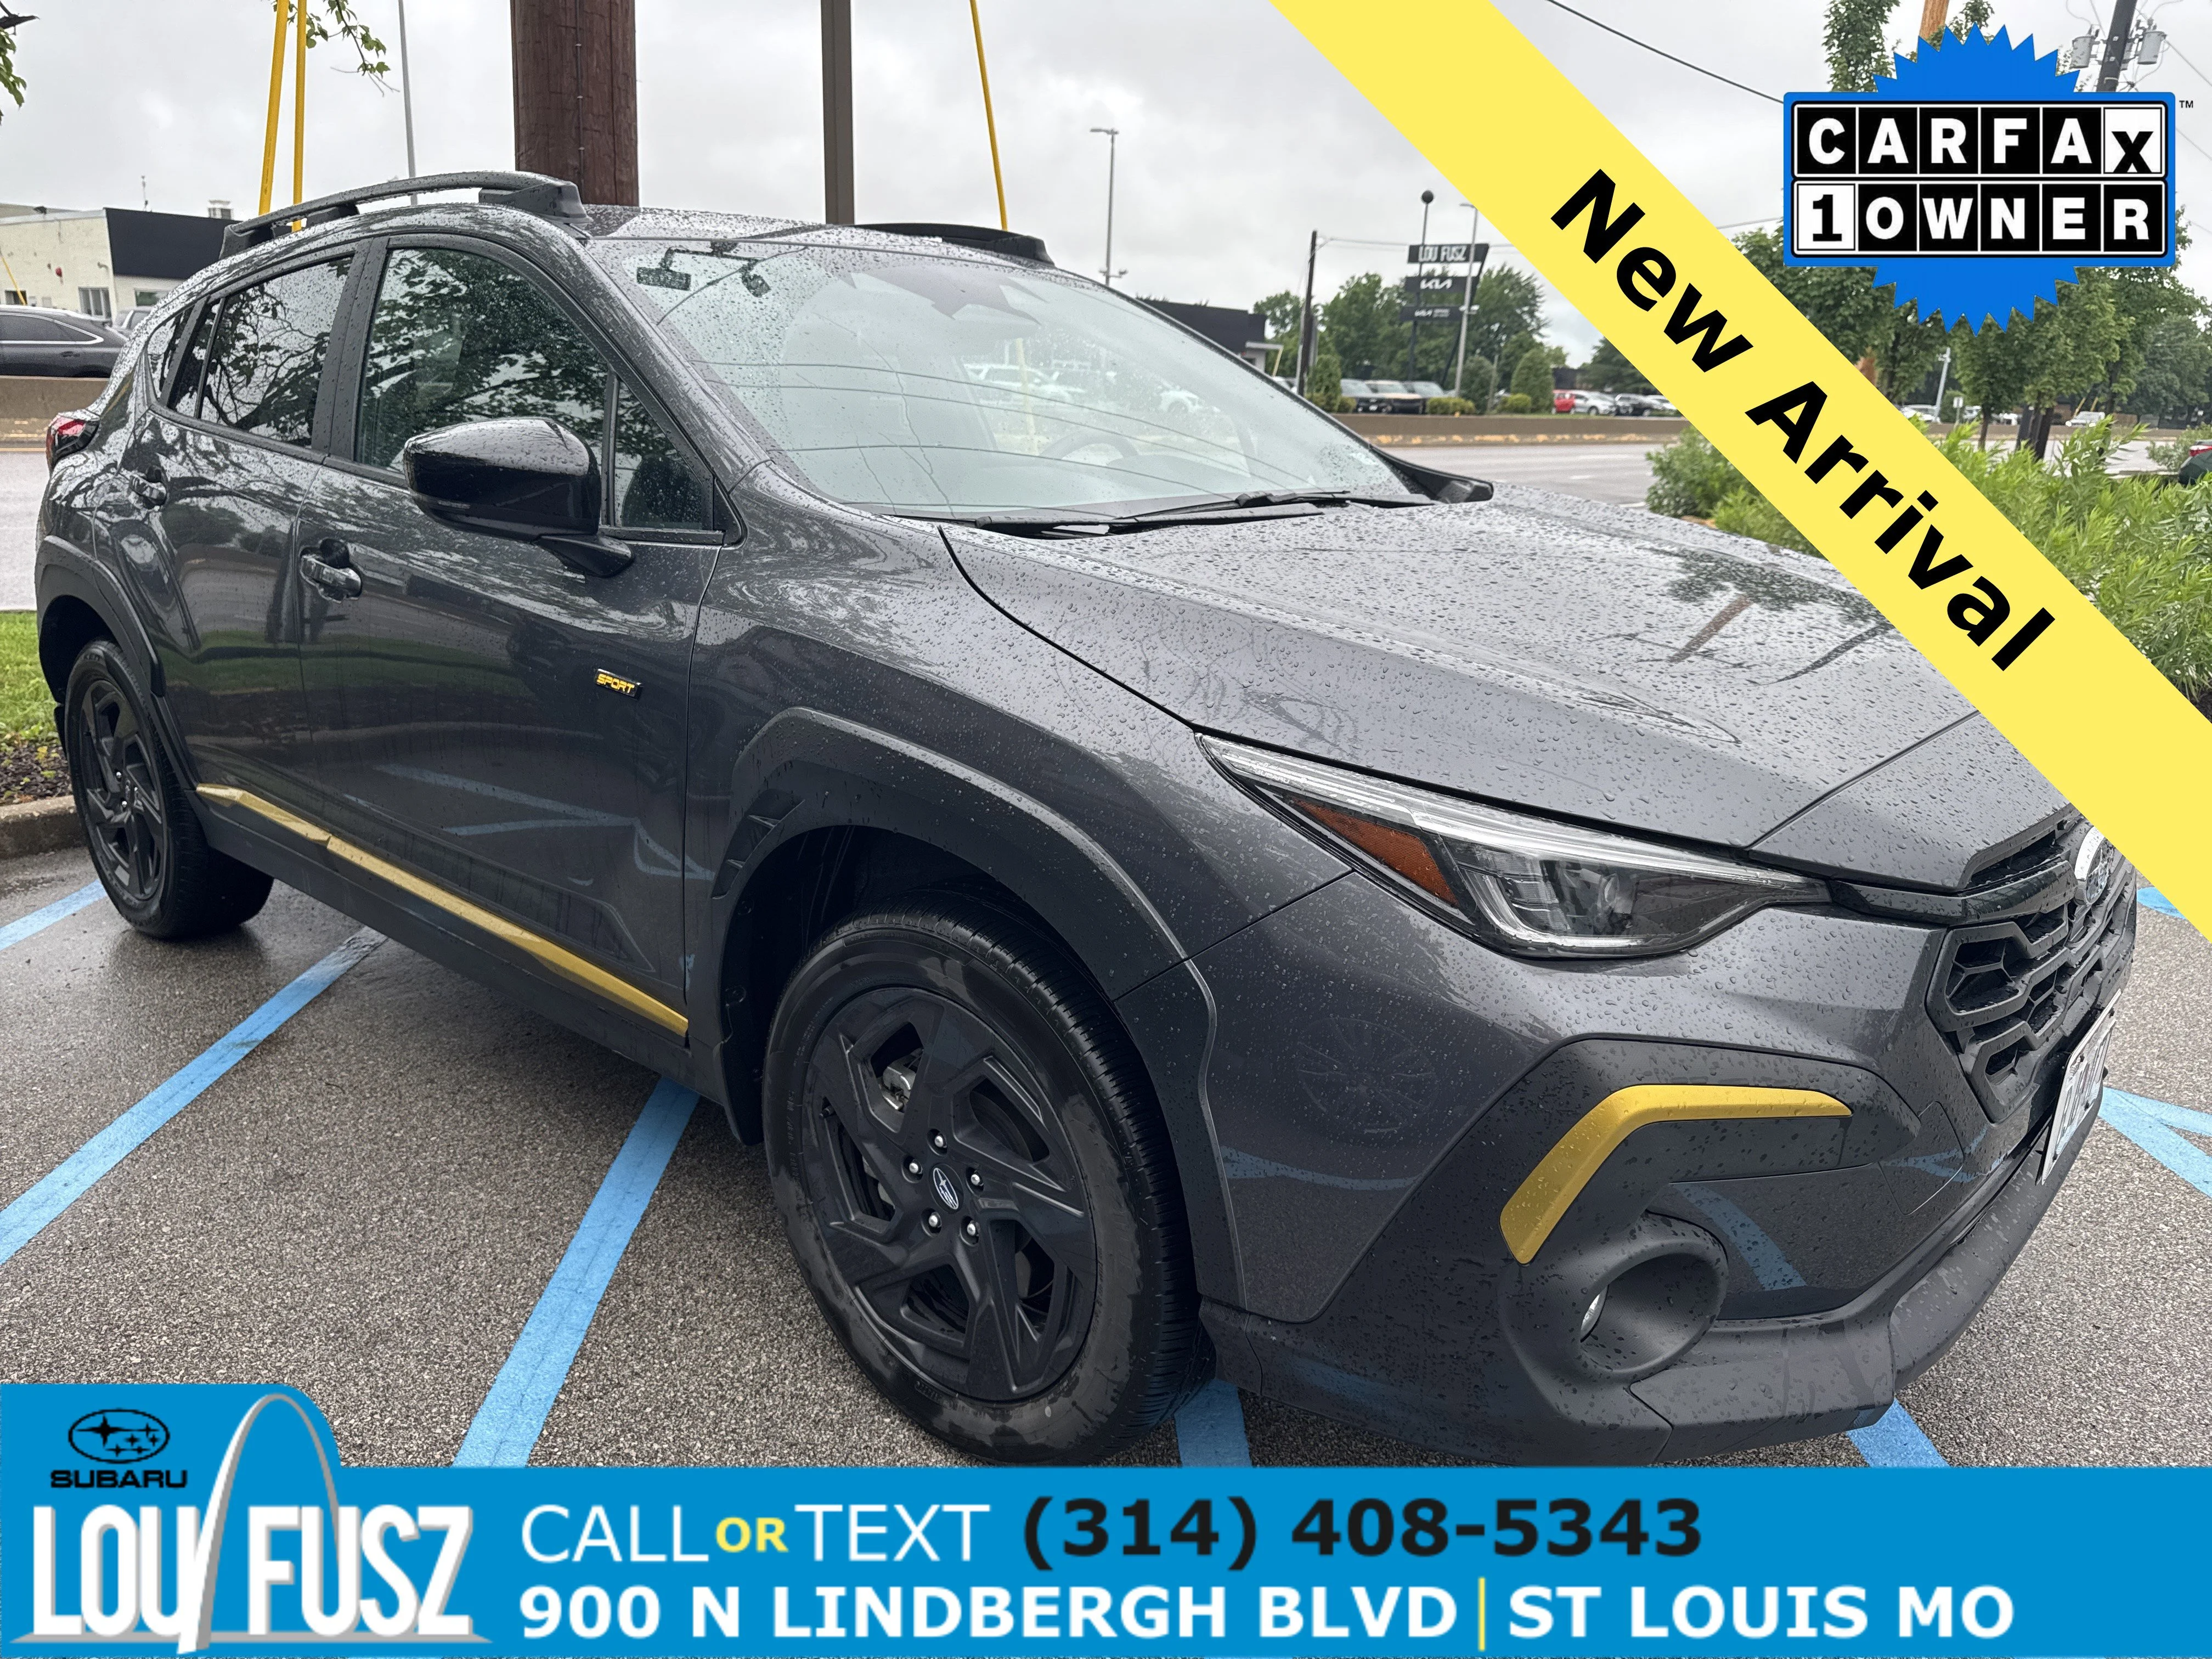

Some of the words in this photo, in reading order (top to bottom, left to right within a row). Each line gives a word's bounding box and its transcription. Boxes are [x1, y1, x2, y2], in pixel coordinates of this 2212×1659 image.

[1418, 246, 1438, 262] LOU
[1440, 245, 1467, 262] FUSZ
[596, 673, 635, 693] SPORT
